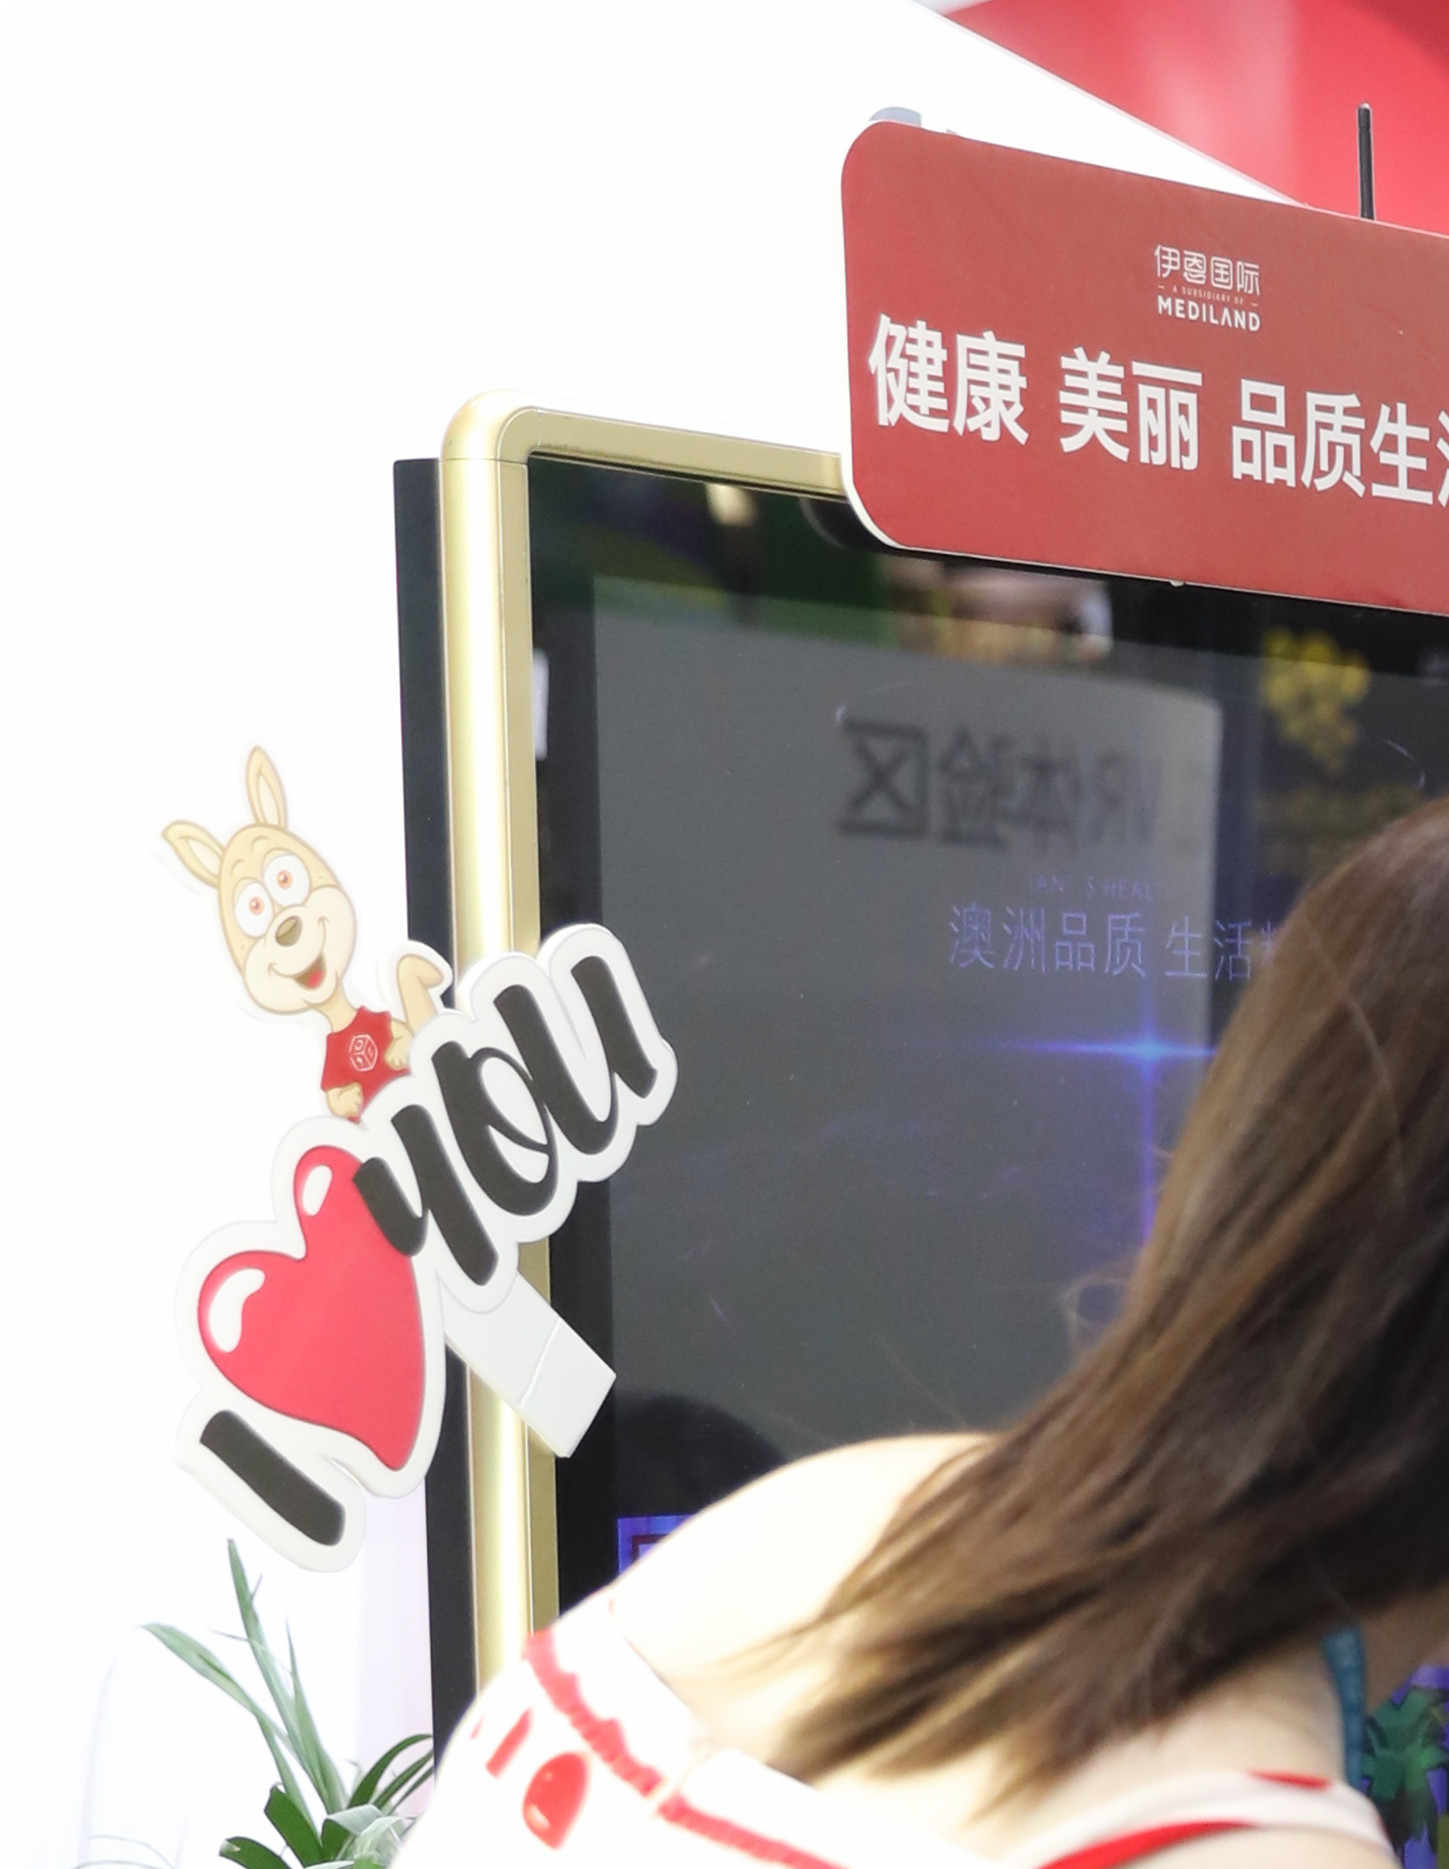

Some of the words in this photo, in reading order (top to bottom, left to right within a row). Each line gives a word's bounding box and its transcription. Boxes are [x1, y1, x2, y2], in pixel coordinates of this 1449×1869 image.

[1157, 294, 1261, 332] MEDILAND
[867, 313, 1028, 445] 健康
[1058, 347, 1203, 470] 美丽
[949, 903, 1146, 978] 澳洲品质
[352, 954, 659, 1287] you
